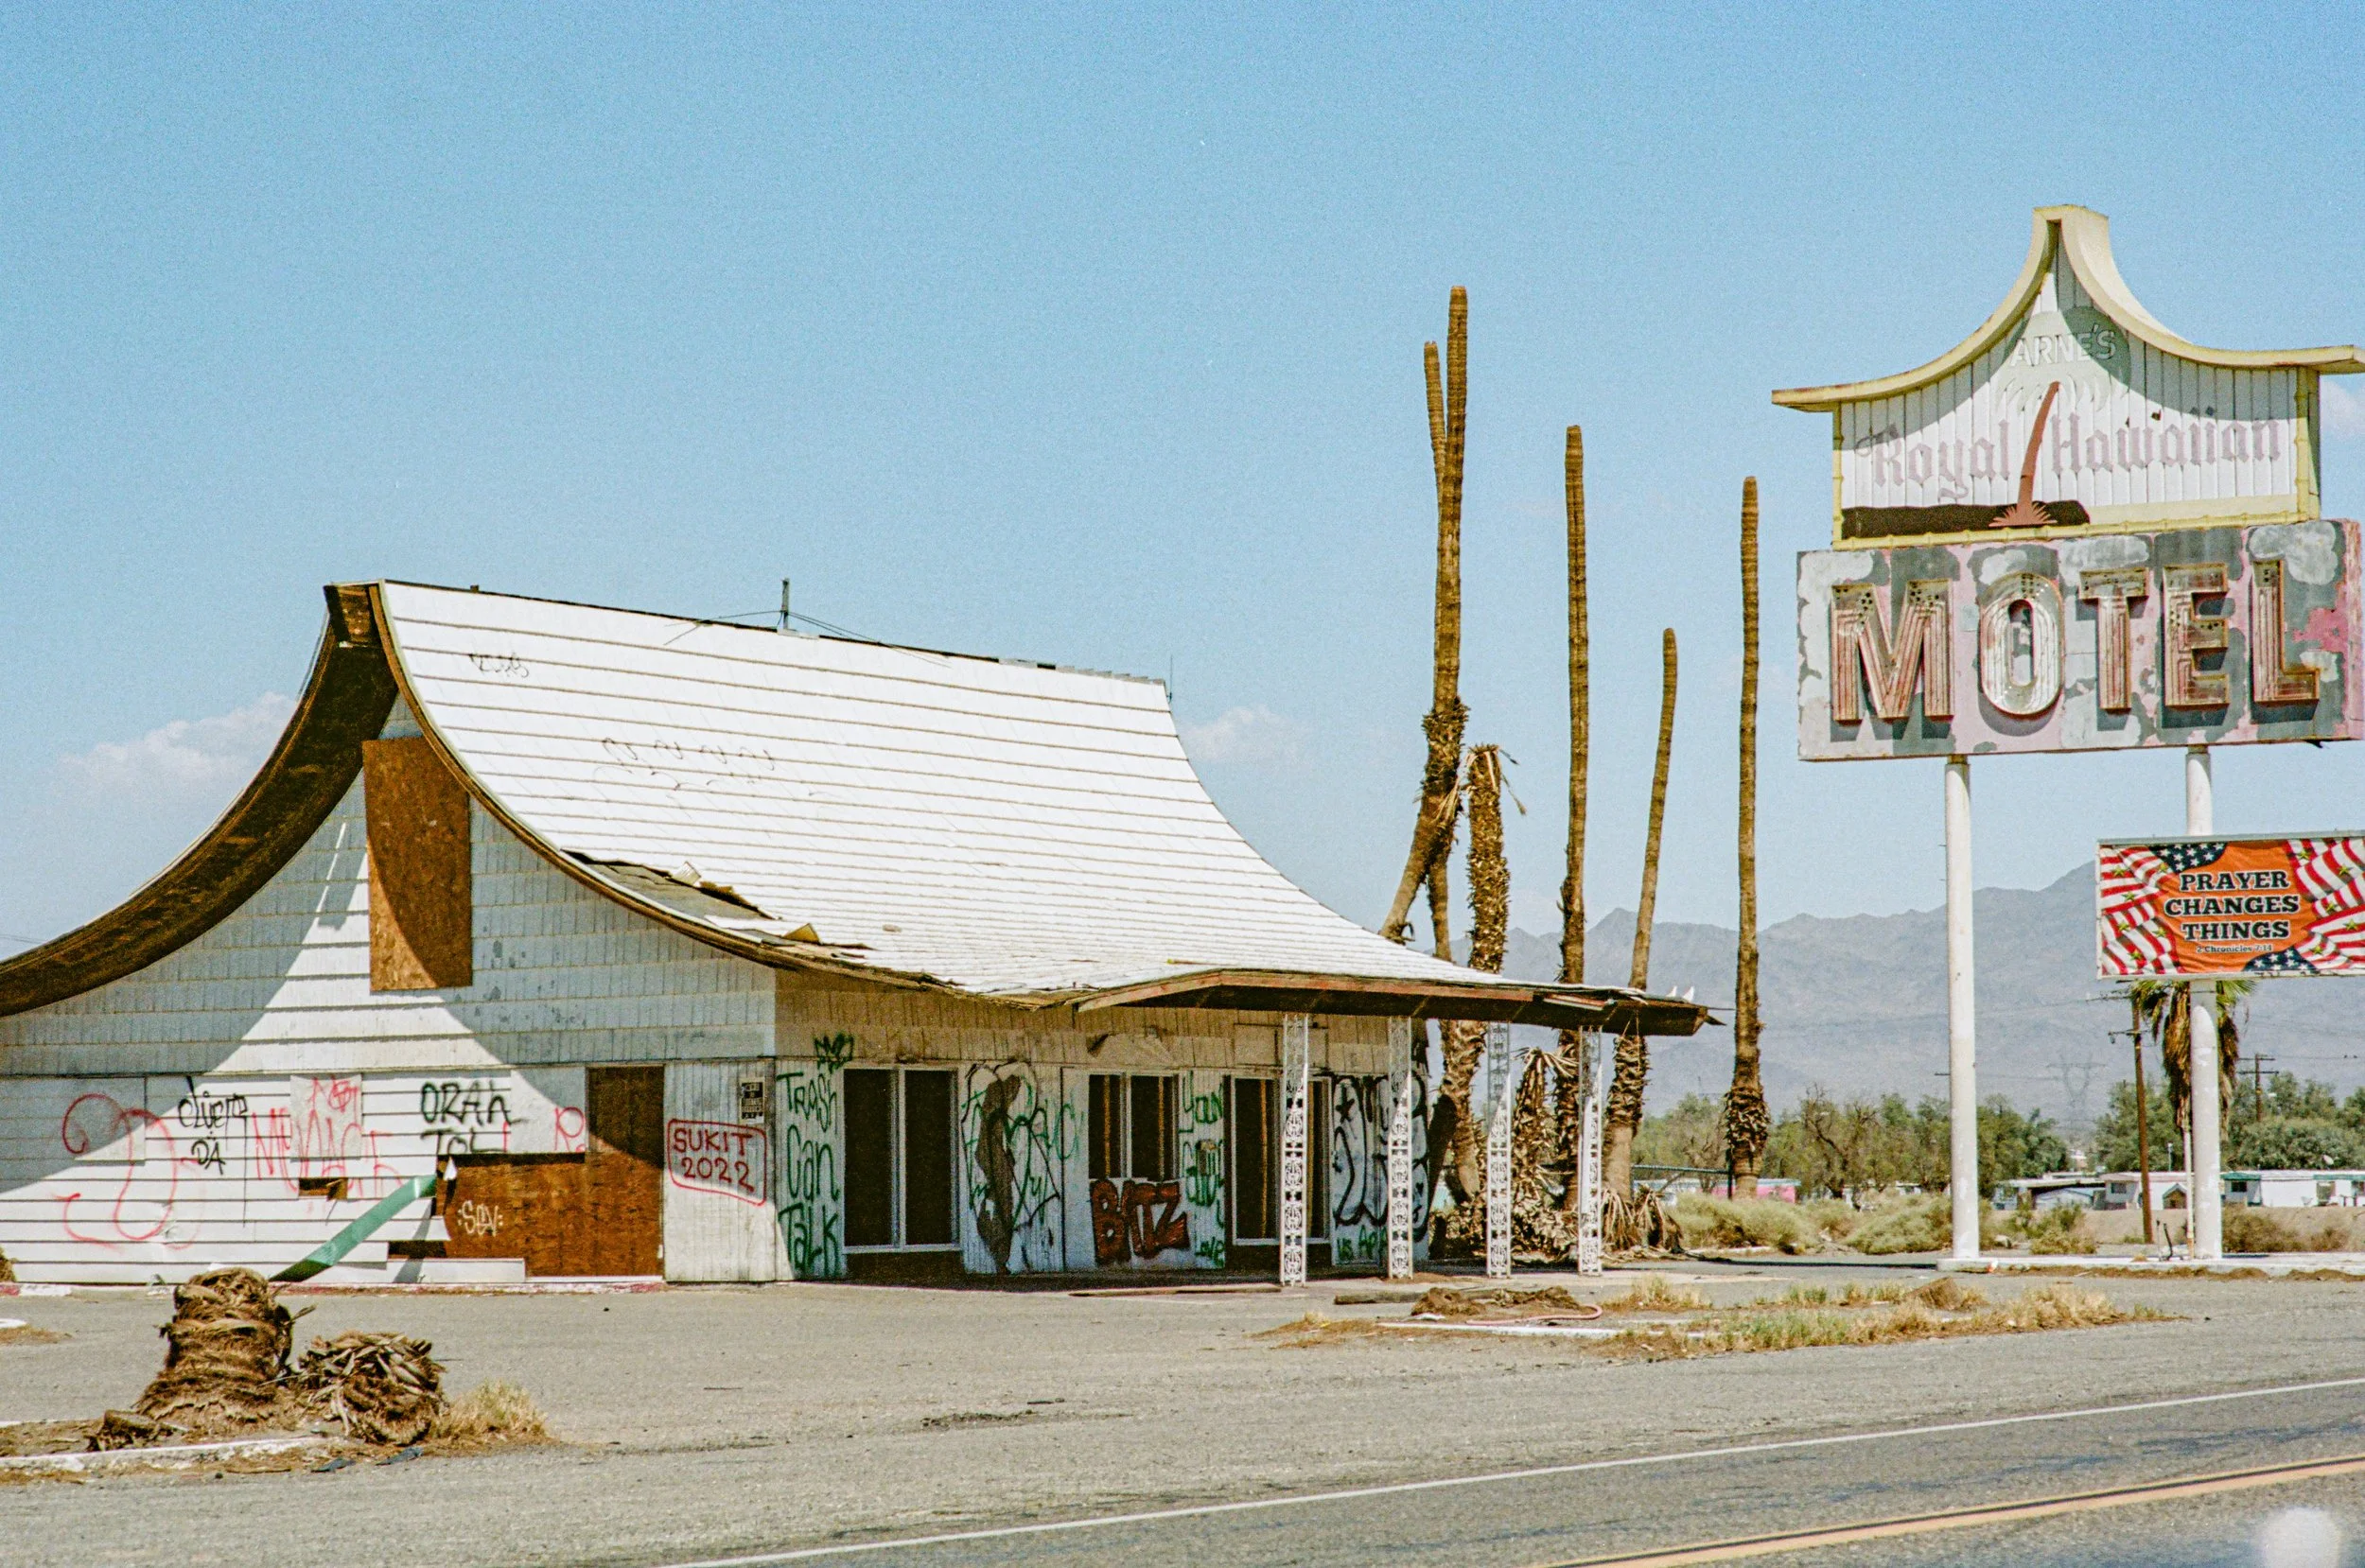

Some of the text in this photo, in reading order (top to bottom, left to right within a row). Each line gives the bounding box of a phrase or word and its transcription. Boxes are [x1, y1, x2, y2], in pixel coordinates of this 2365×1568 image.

[2010, 323, 2116, 367] ARNE'S
[1855, 412, 2281, 499] Royal Hawaiian
[1830, 559, 2321, 725] MOTEL
[2180, 870, 2290, 892] PRAYER
[2164, 895, 2300, 916] CHANGES
[2181, 920, 2290, 941] THINGS
[674, 1127, 754, 1157] SUKIT
[681, 1157, 756, 1193] 2022
